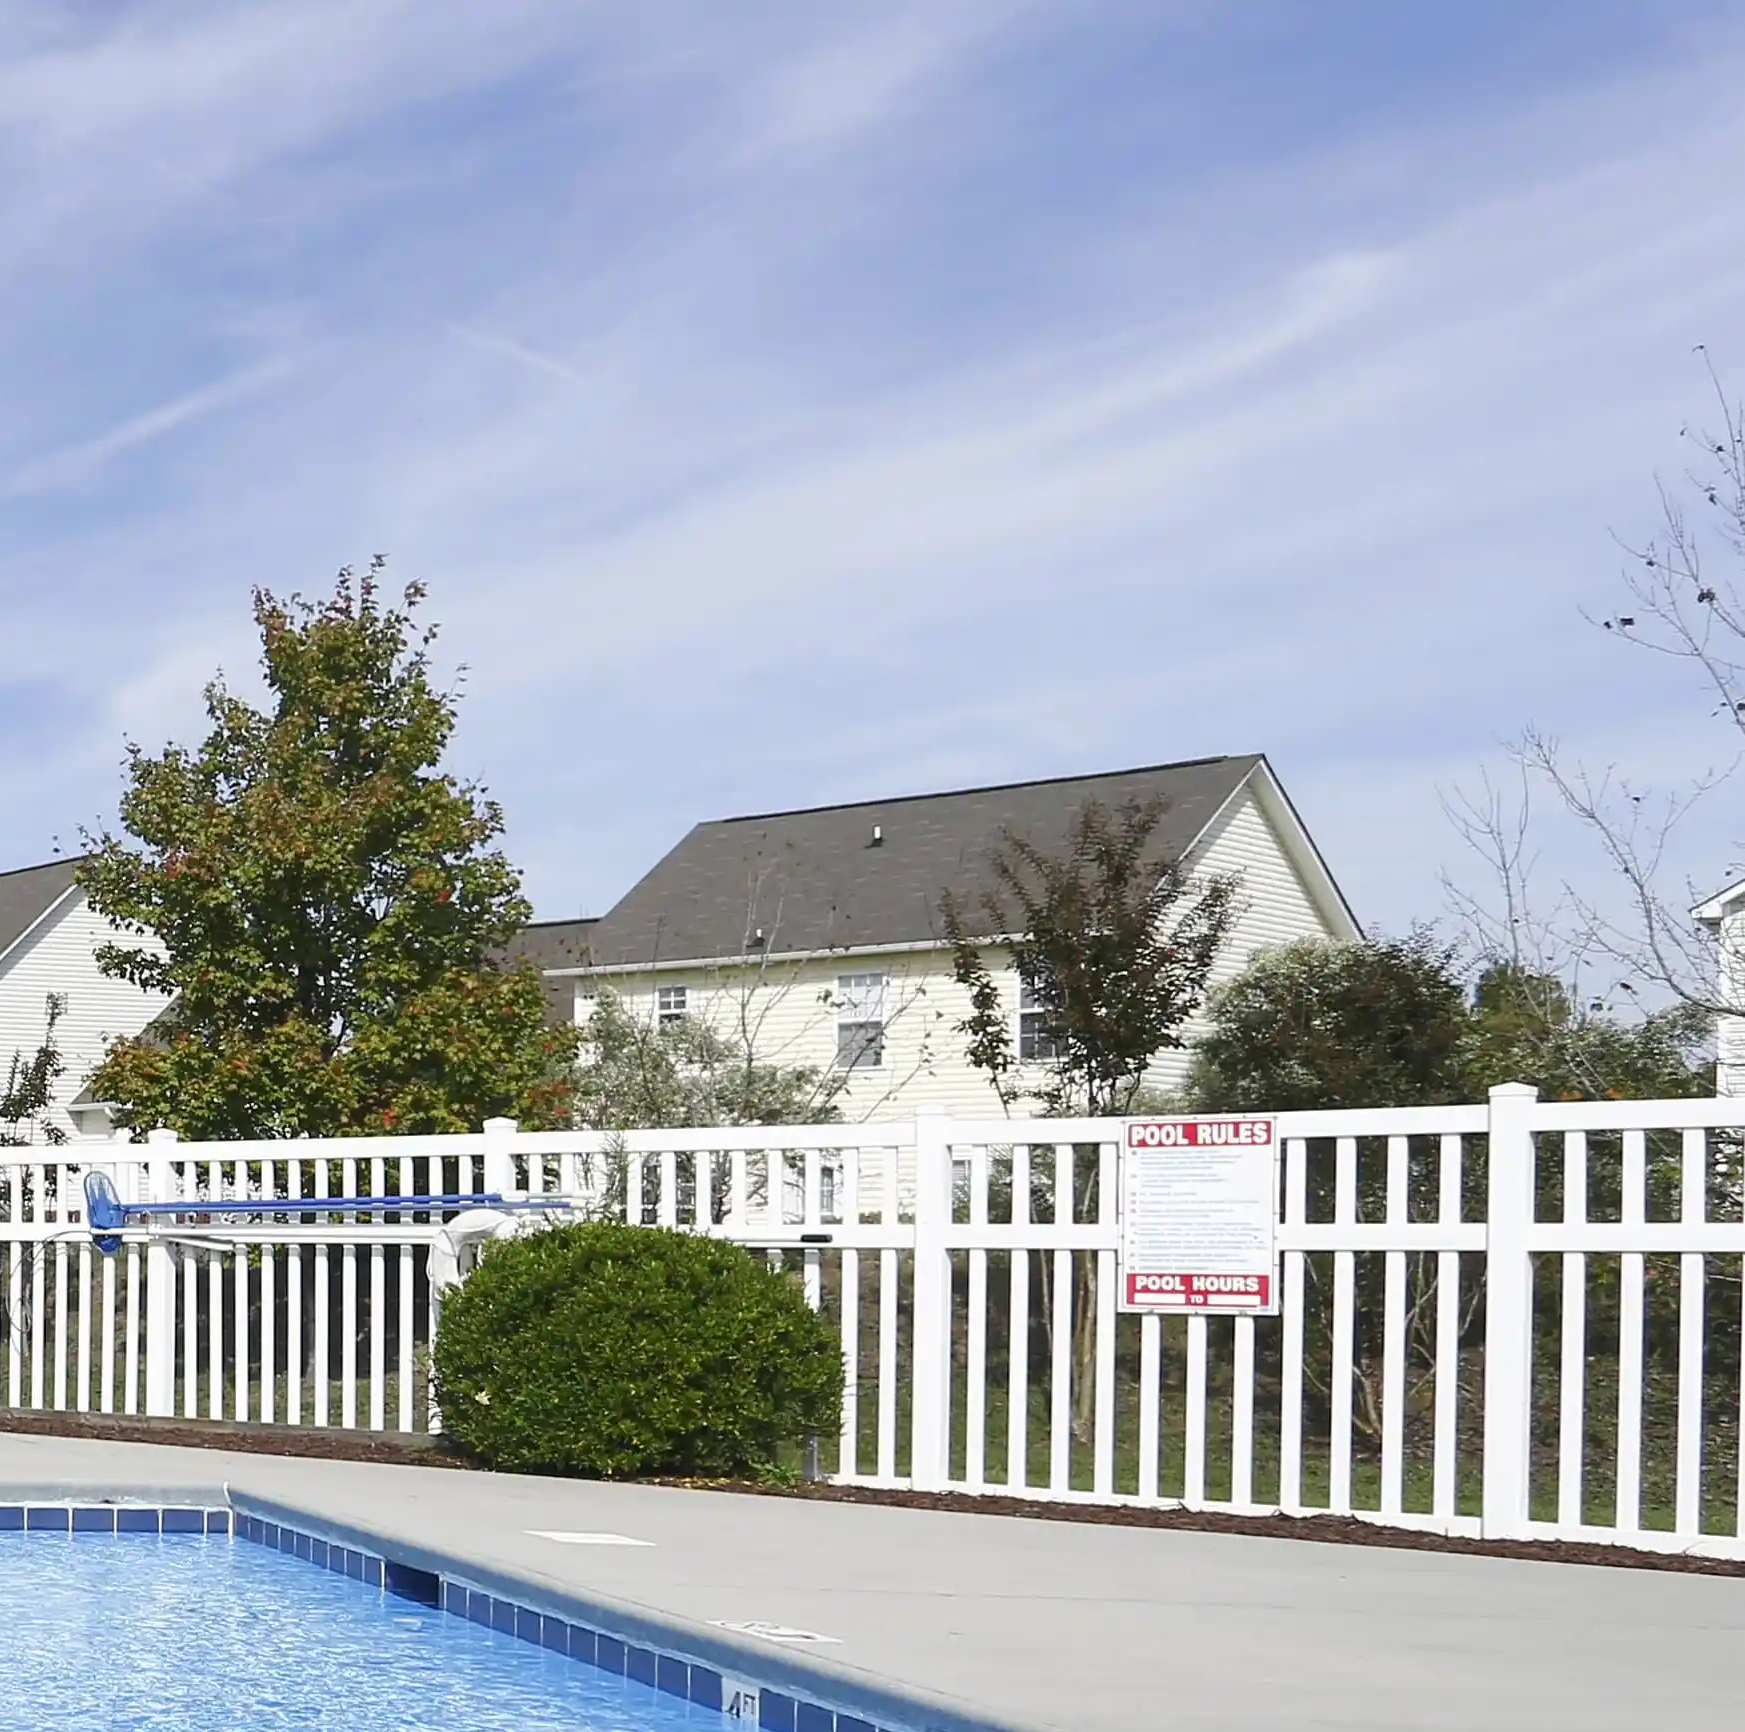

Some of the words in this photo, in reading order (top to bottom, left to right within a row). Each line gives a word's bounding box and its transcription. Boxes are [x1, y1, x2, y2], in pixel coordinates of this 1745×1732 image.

[1130, 1124, 1189, 1146] POOL
[1196, 1122, 1269, 1145] RULES
[1135, 1276, 1187, 1291] POOL
[1192, 1277, 1260, 1292] HOURS
[1189, 1295, 1204, 1304] TO
